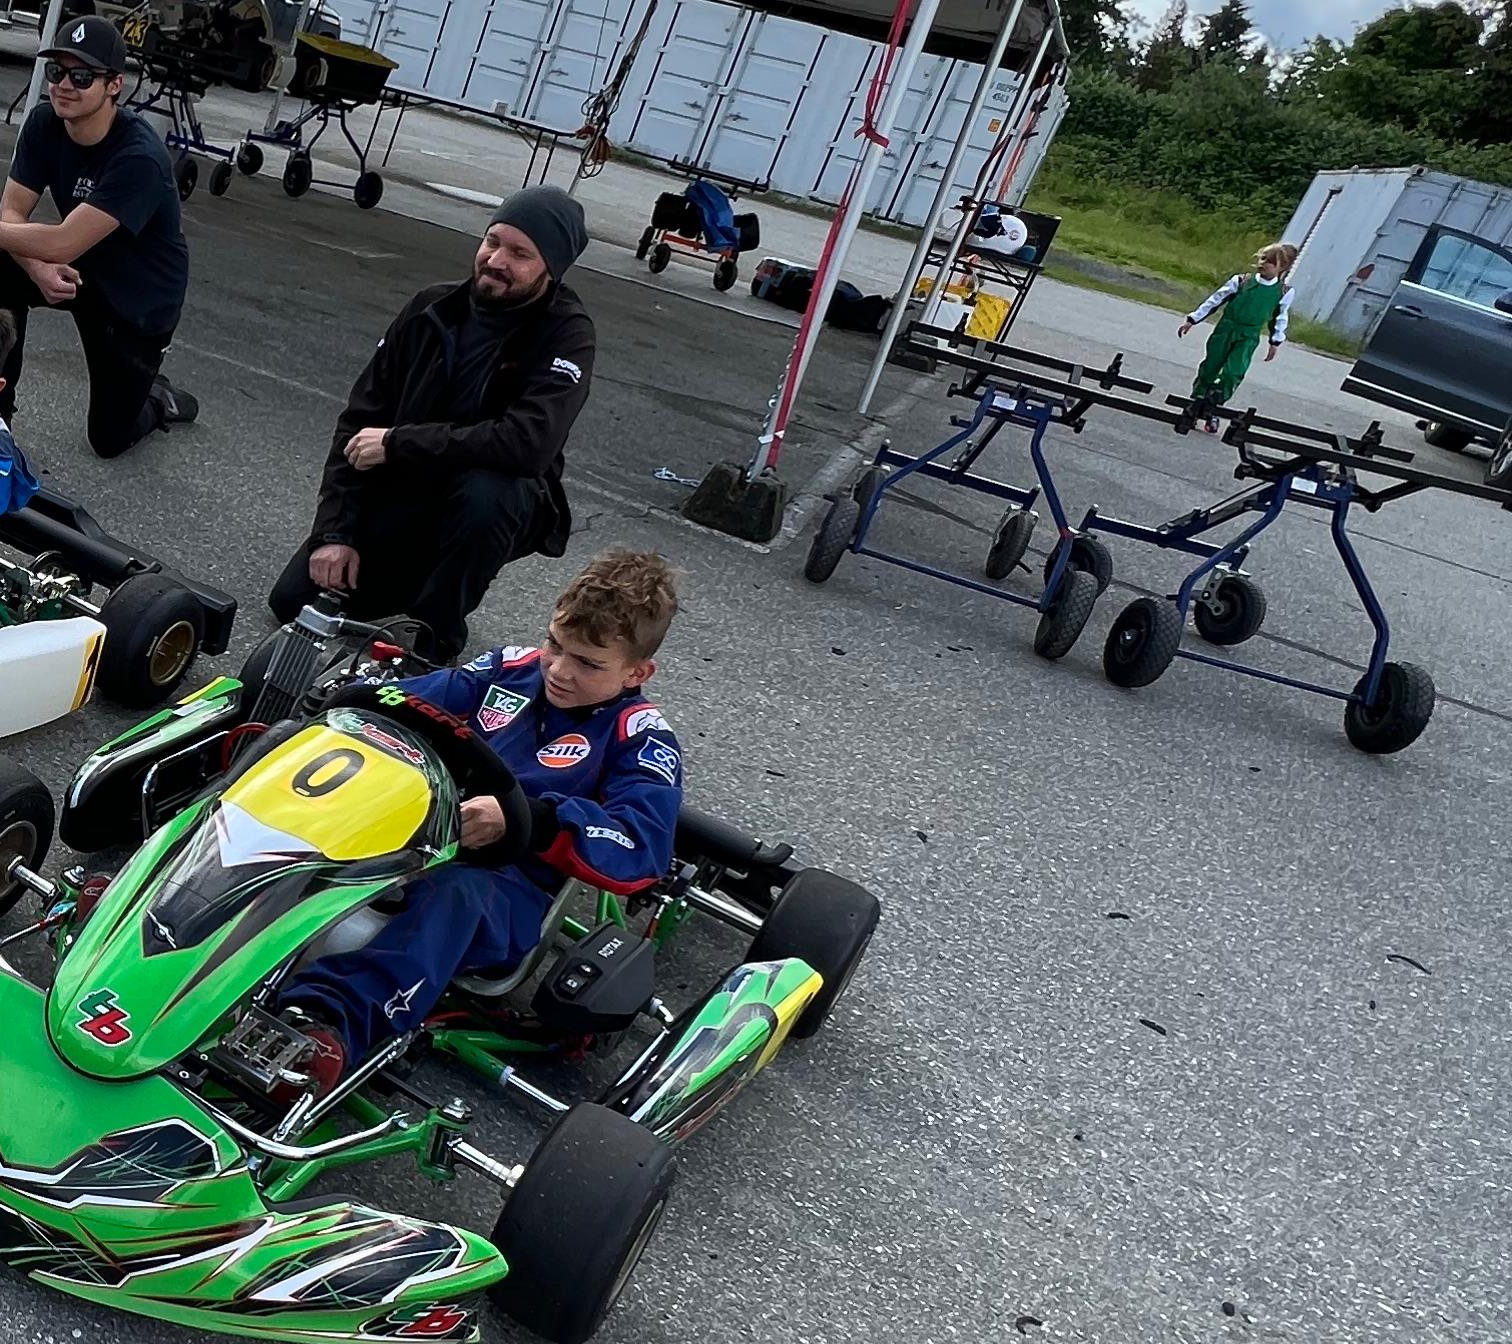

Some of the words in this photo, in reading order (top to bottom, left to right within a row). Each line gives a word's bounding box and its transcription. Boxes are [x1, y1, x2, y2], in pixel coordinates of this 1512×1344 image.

[123, 16, 149, 45] 23
[492, 692, 518, 713] TAG
[292, 748, 365, 798] 0
[598, 937, 624, 959] ROTAX
